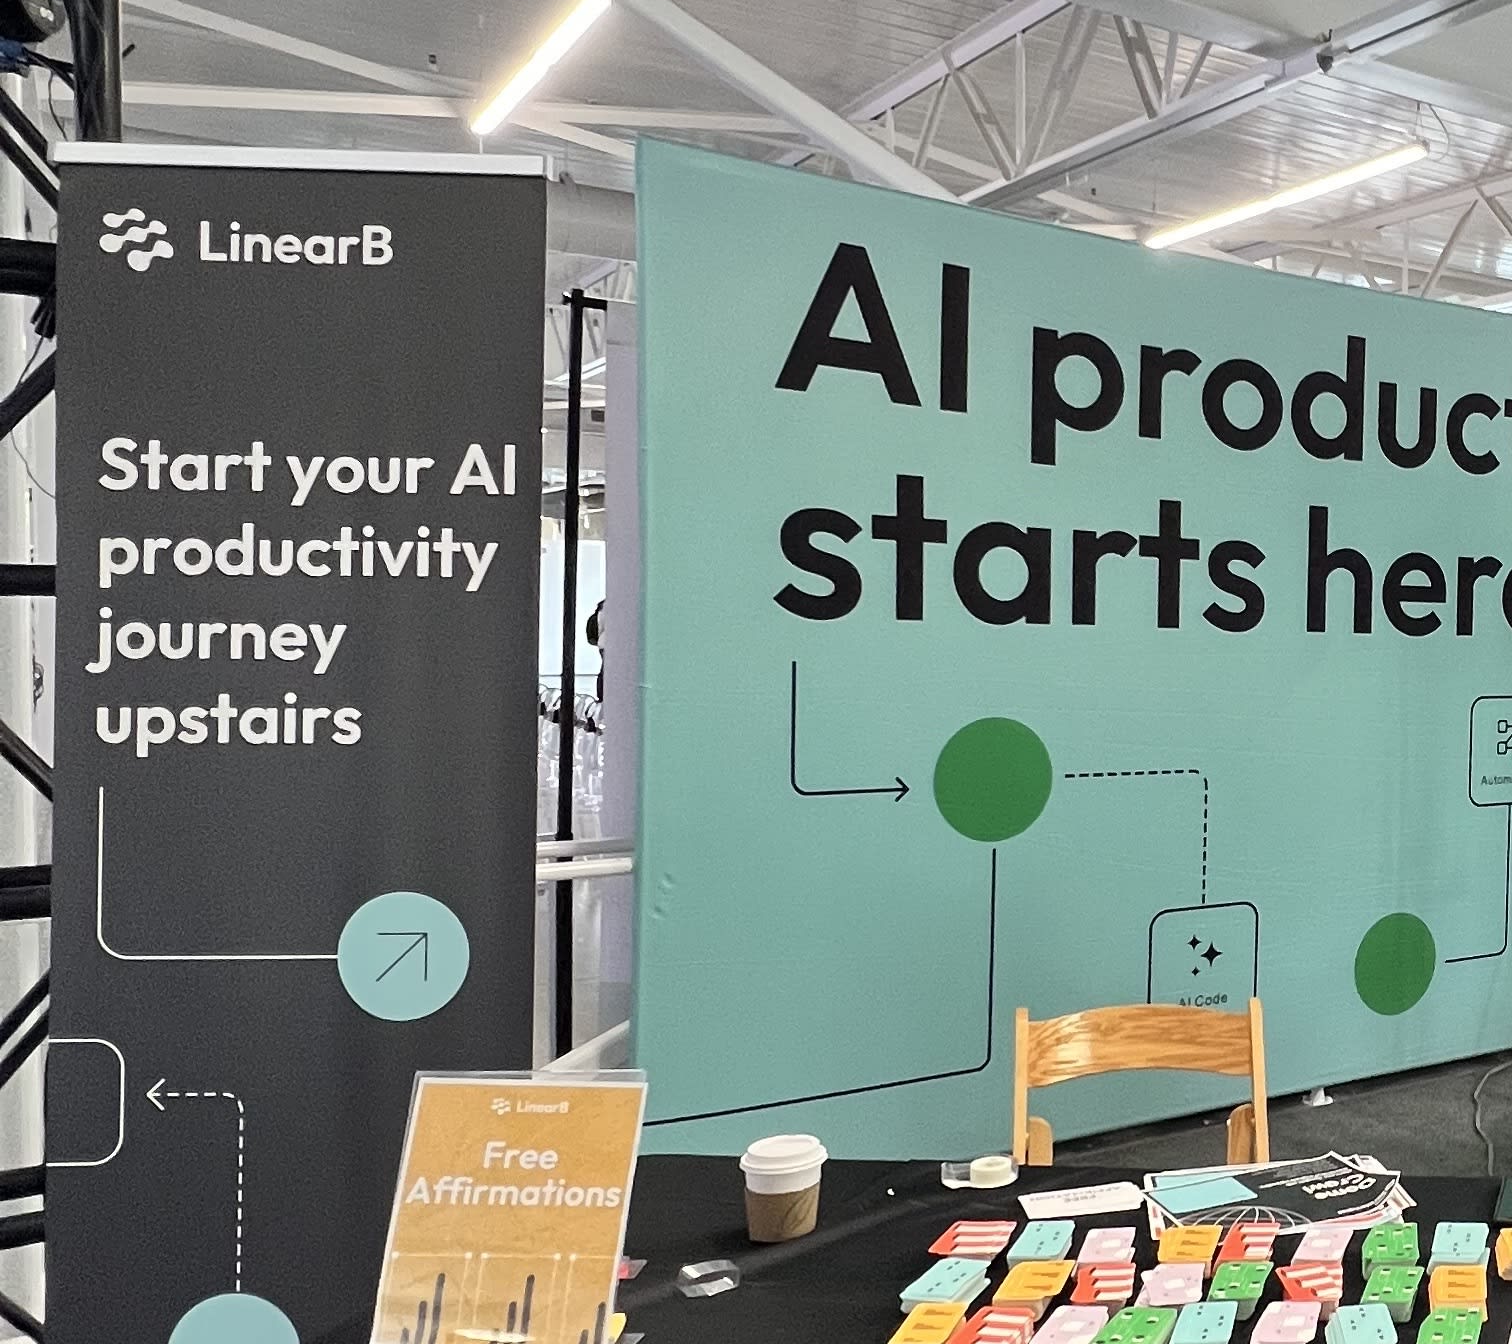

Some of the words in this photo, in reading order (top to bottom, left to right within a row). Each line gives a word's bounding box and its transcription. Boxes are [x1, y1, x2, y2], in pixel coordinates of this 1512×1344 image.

[199, 220, 394, 266] LinearB
[775, 242, 970, 414] AI
[99, 437, 272, 492] Start
[286, 455, 435, 506] your
[450, 443, 516, 495] AI
[100, 522, 499, 592] productivity
[773, 474, 1267, 633] starts
[85, 606, 347, 675] journey
[96, 692, 363, 758] upstairs
[1195, 994, 1228, 1007] Code
[516, 1099, 570, 1114] LinearB
[482, 1141, 559, 1170] Free
[406, 1175, 622, 1208] Affirmations
